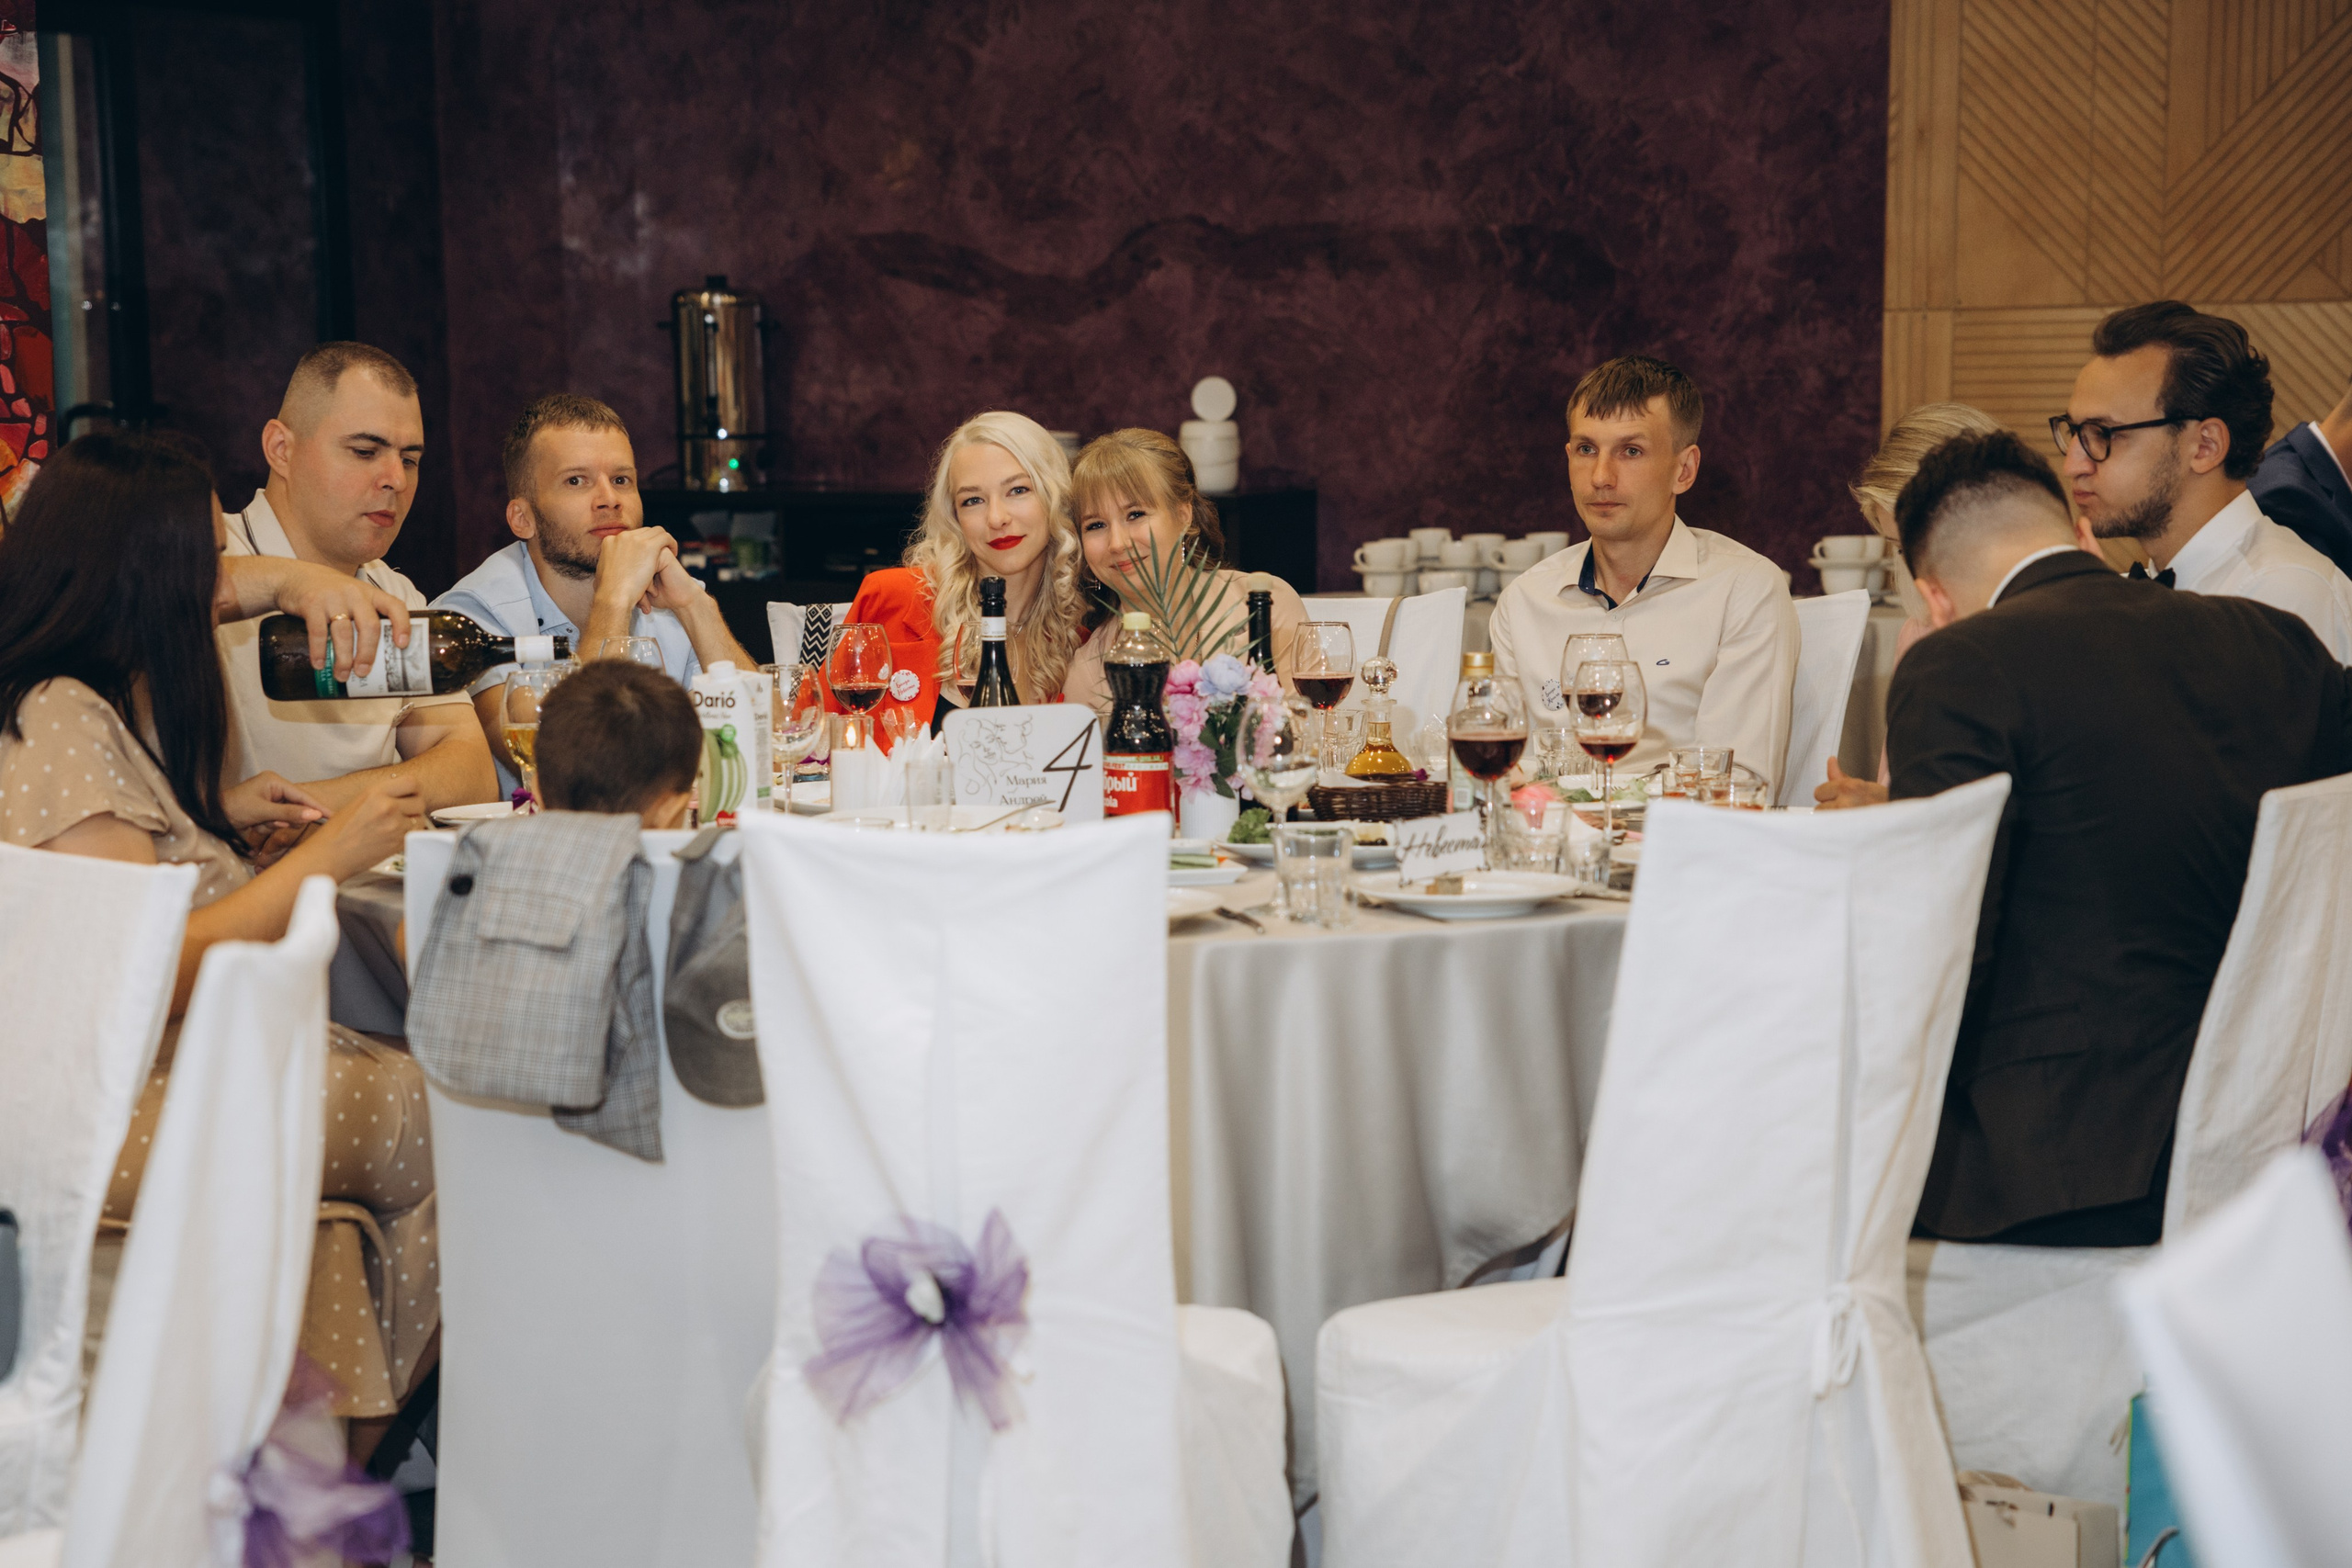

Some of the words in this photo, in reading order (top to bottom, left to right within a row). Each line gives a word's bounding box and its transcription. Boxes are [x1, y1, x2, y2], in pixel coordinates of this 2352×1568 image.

[1042, 717, 1097, 813] 4
[1006, 774, 1047, 788] Мария
[1103, 771, 1137, 794] брый
